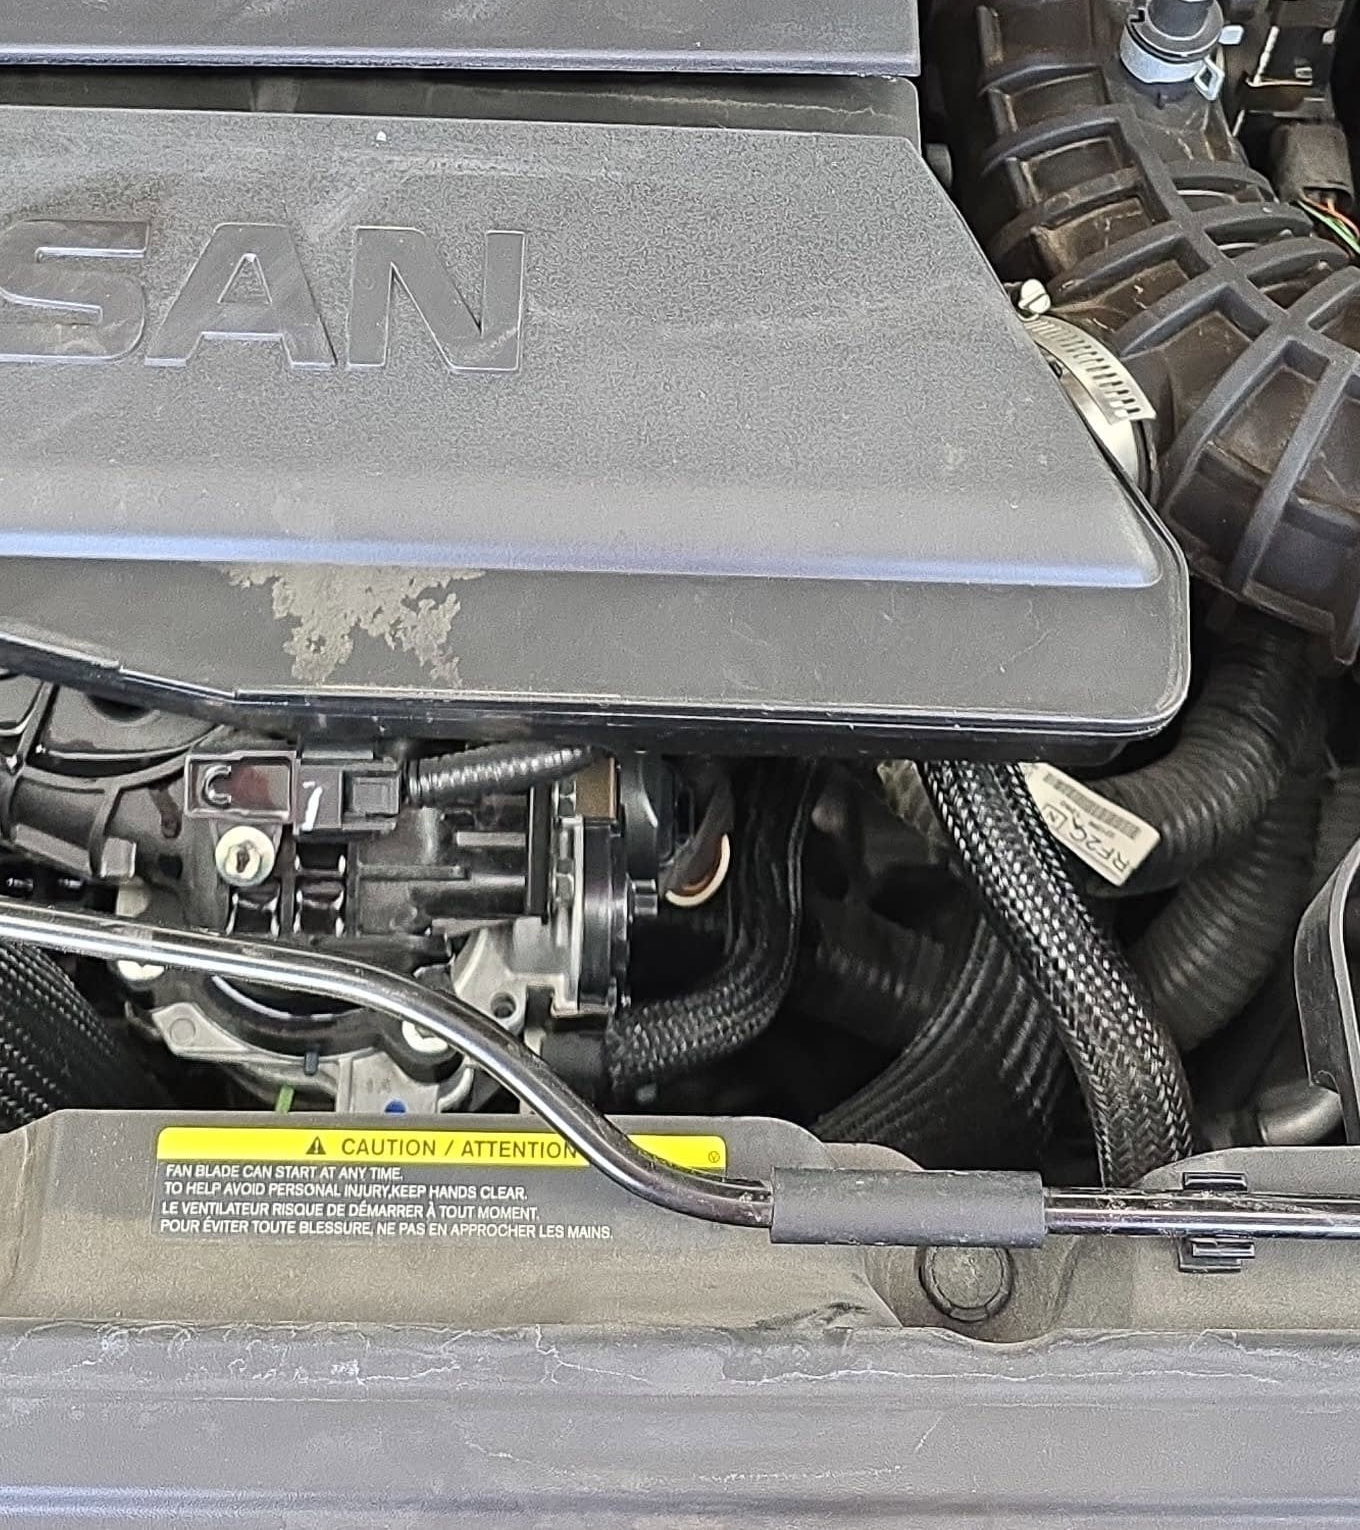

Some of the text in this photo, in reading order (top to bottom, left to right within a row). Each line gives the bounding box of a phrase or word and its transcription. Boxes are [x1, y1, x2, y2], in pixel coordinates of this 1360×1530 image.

[341, 1137, 577, 1159] CAUTION / ATTENTION
[165, 1164, 403, 1180] FAN BLADE CAN START AT ANY TIME.
[164, 1181, 528, 1200] TO HELP AVOID PERSONAL INJURY,KEEP HANDS CLEAR.
[161, 1201, 540, 1220] LE VENTILATEUR RISQUE DE DÉMARRER À TOUT MOMENT.
[160, 1217, 613, 1239] POUR ÉVITER TOUTE BLESSURE, NE PAS EN APPROCHER LES MAINS.
